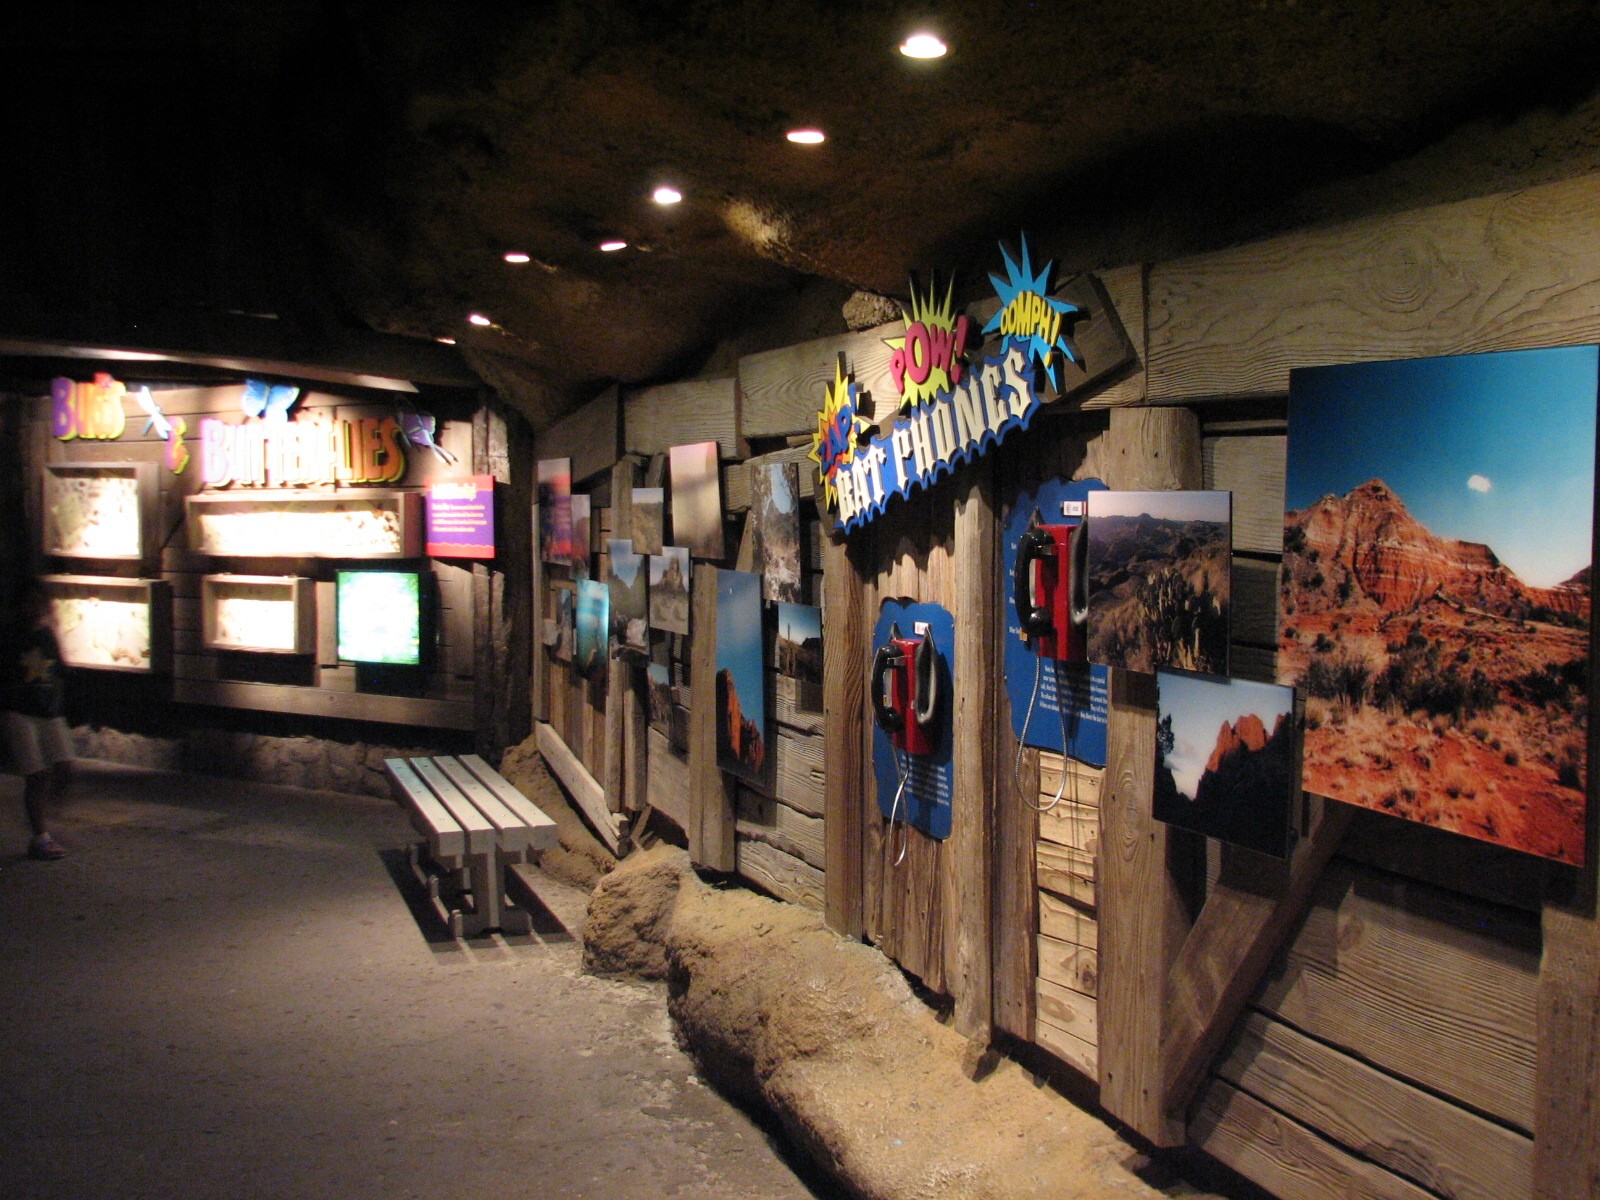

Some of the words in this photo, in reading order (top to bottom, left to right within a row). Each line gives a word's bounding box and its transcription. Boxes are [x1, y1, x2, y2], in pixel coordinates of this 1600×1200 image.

[890, 314, 970, 394] POW!
[1000, 290, 1063, 367] OOMPH!
[52, 376, 126, 440] BUGS
[201, 417, 405, 487] BUTTERFLIES
[834, 444, 887, 527] BAT
[892, 346, 1032, 492] PHONES
